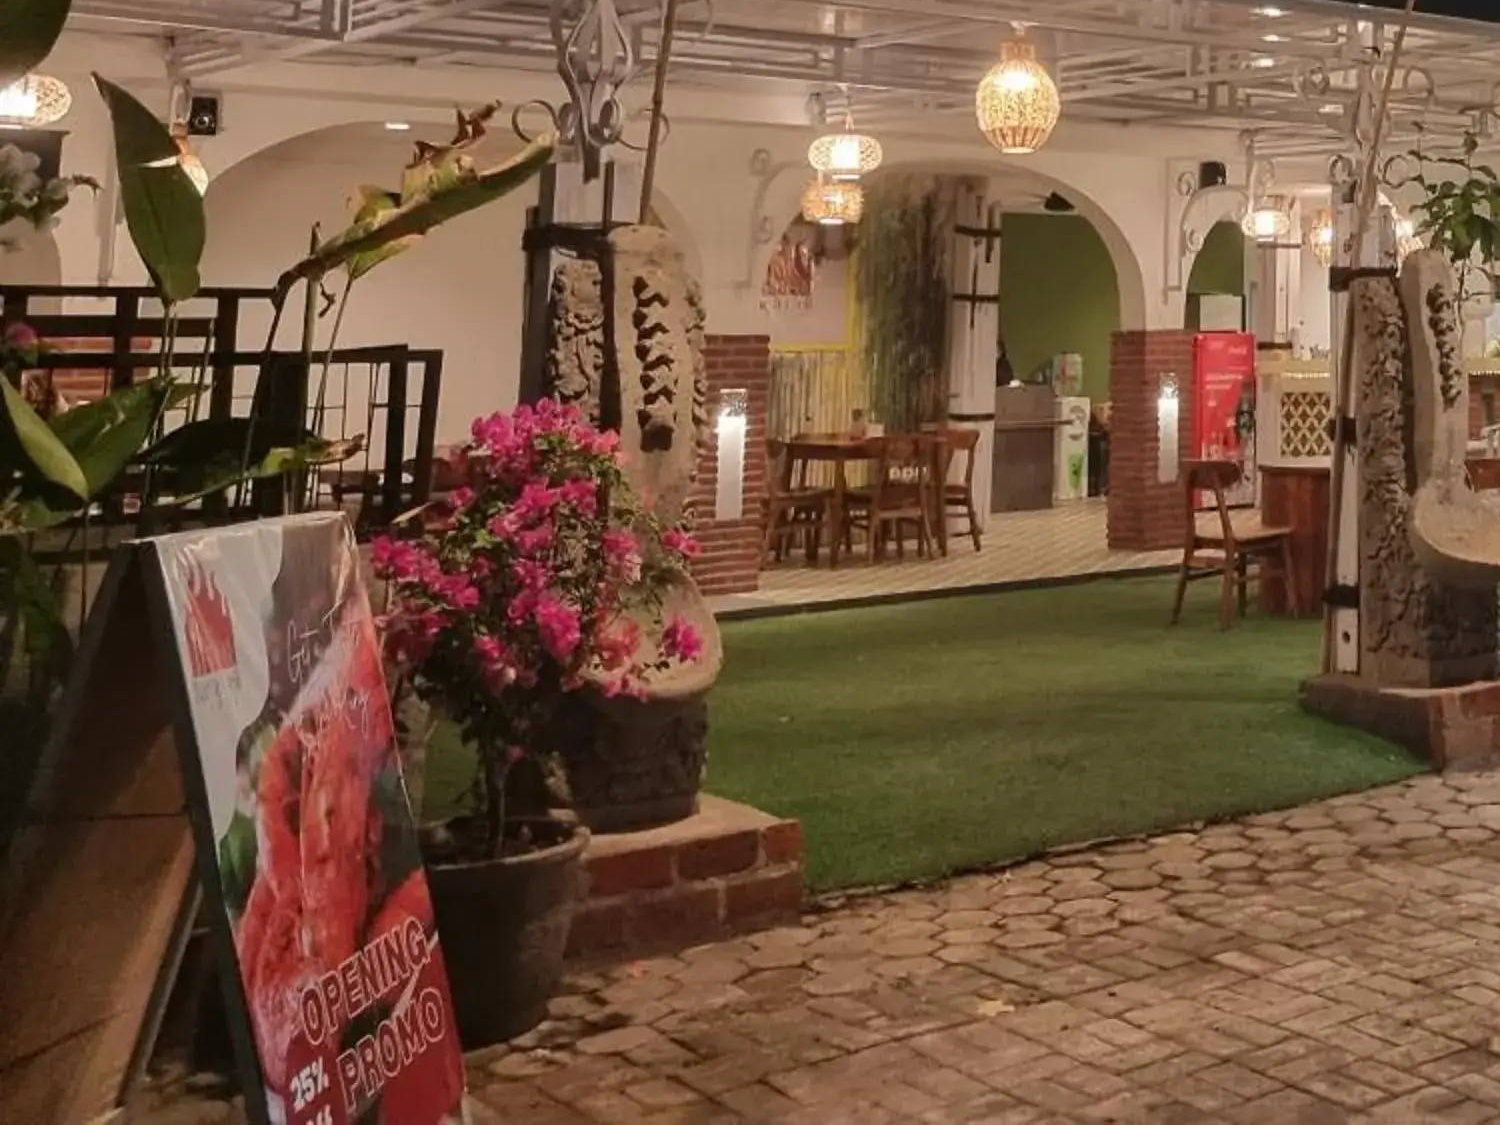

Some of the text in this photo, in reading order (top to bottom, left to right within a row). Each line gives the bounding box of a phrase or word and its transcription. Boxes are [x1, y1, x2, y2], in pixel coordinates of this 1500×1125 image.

[300, 916, 432, 1046] OPENING
[289, 1056, 330, 1114] 25%
[335, 987, 446, 1115] PROMO
